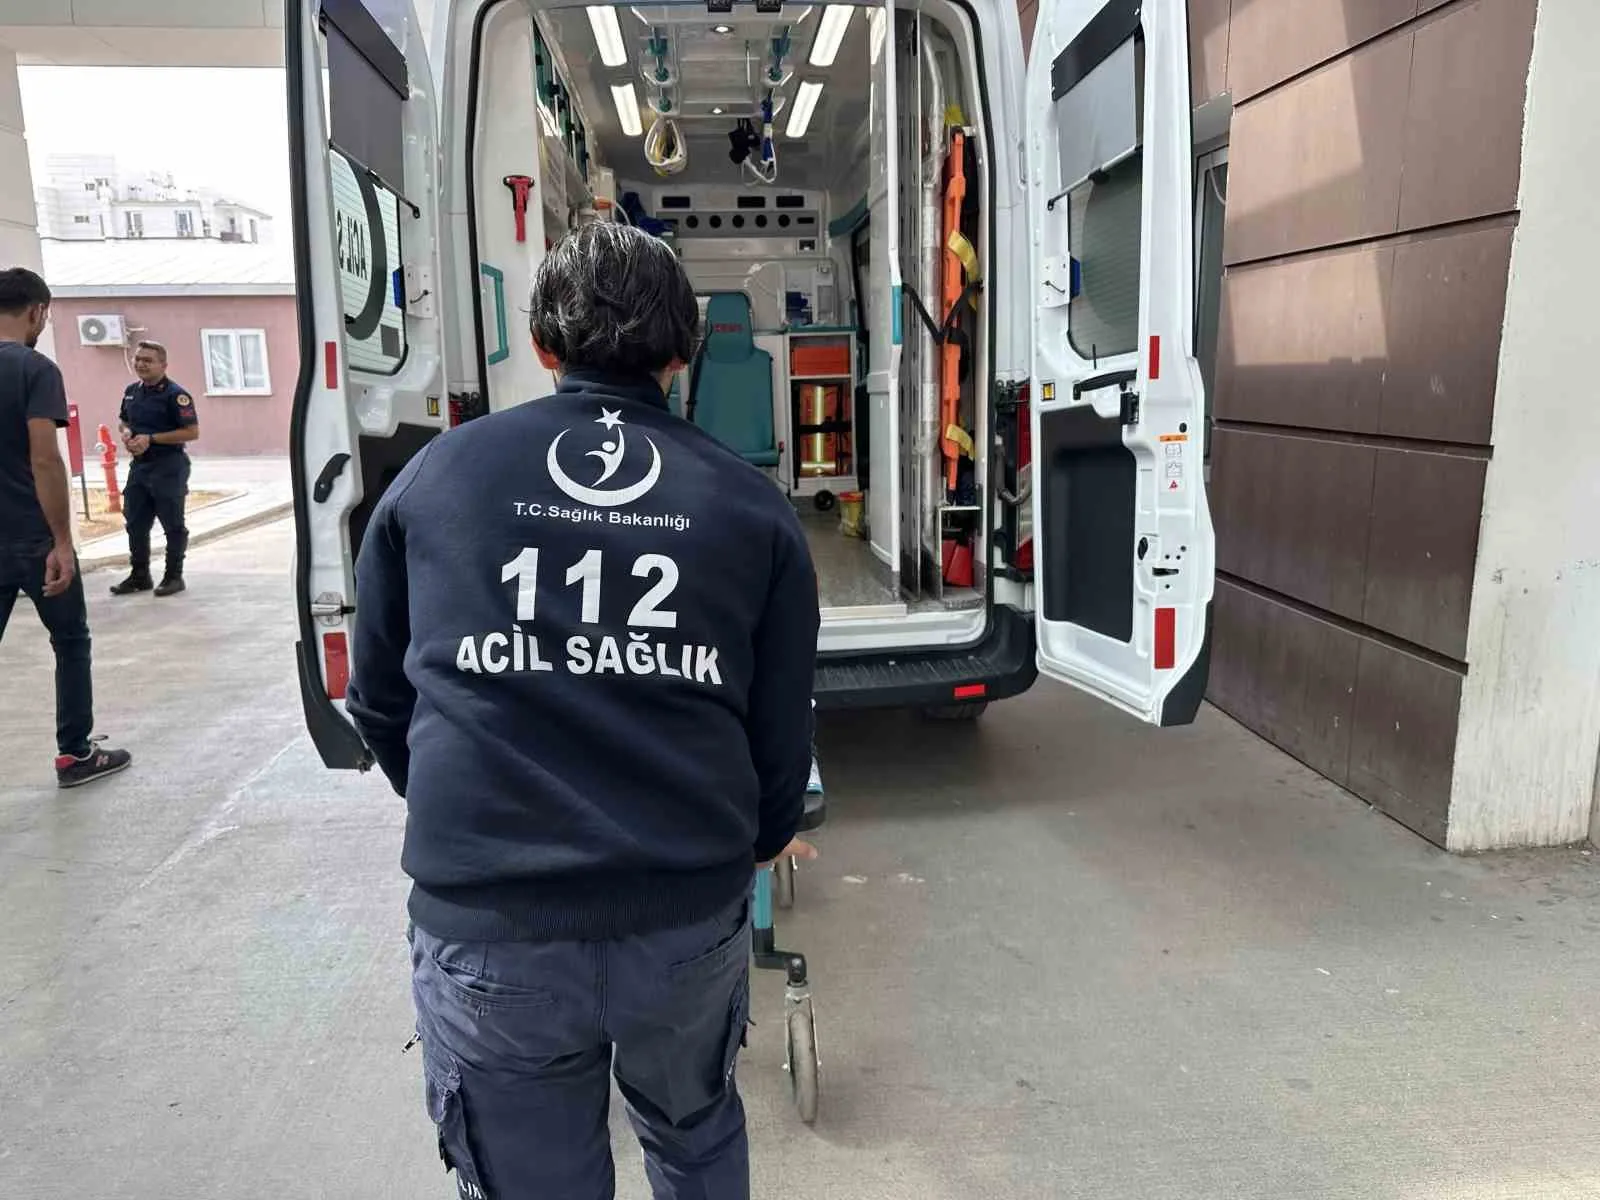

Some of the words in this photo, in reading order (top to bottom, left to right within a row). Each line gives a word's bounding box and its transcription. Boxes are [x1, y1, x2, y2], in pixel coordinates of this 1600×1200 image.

[608, 511, 690, 532] Bakanlığı
[501, 547, 680, 629] 112
[456, 623, 554, 674] ACİL
[566, 631, 723, 685] SAĞLIK
